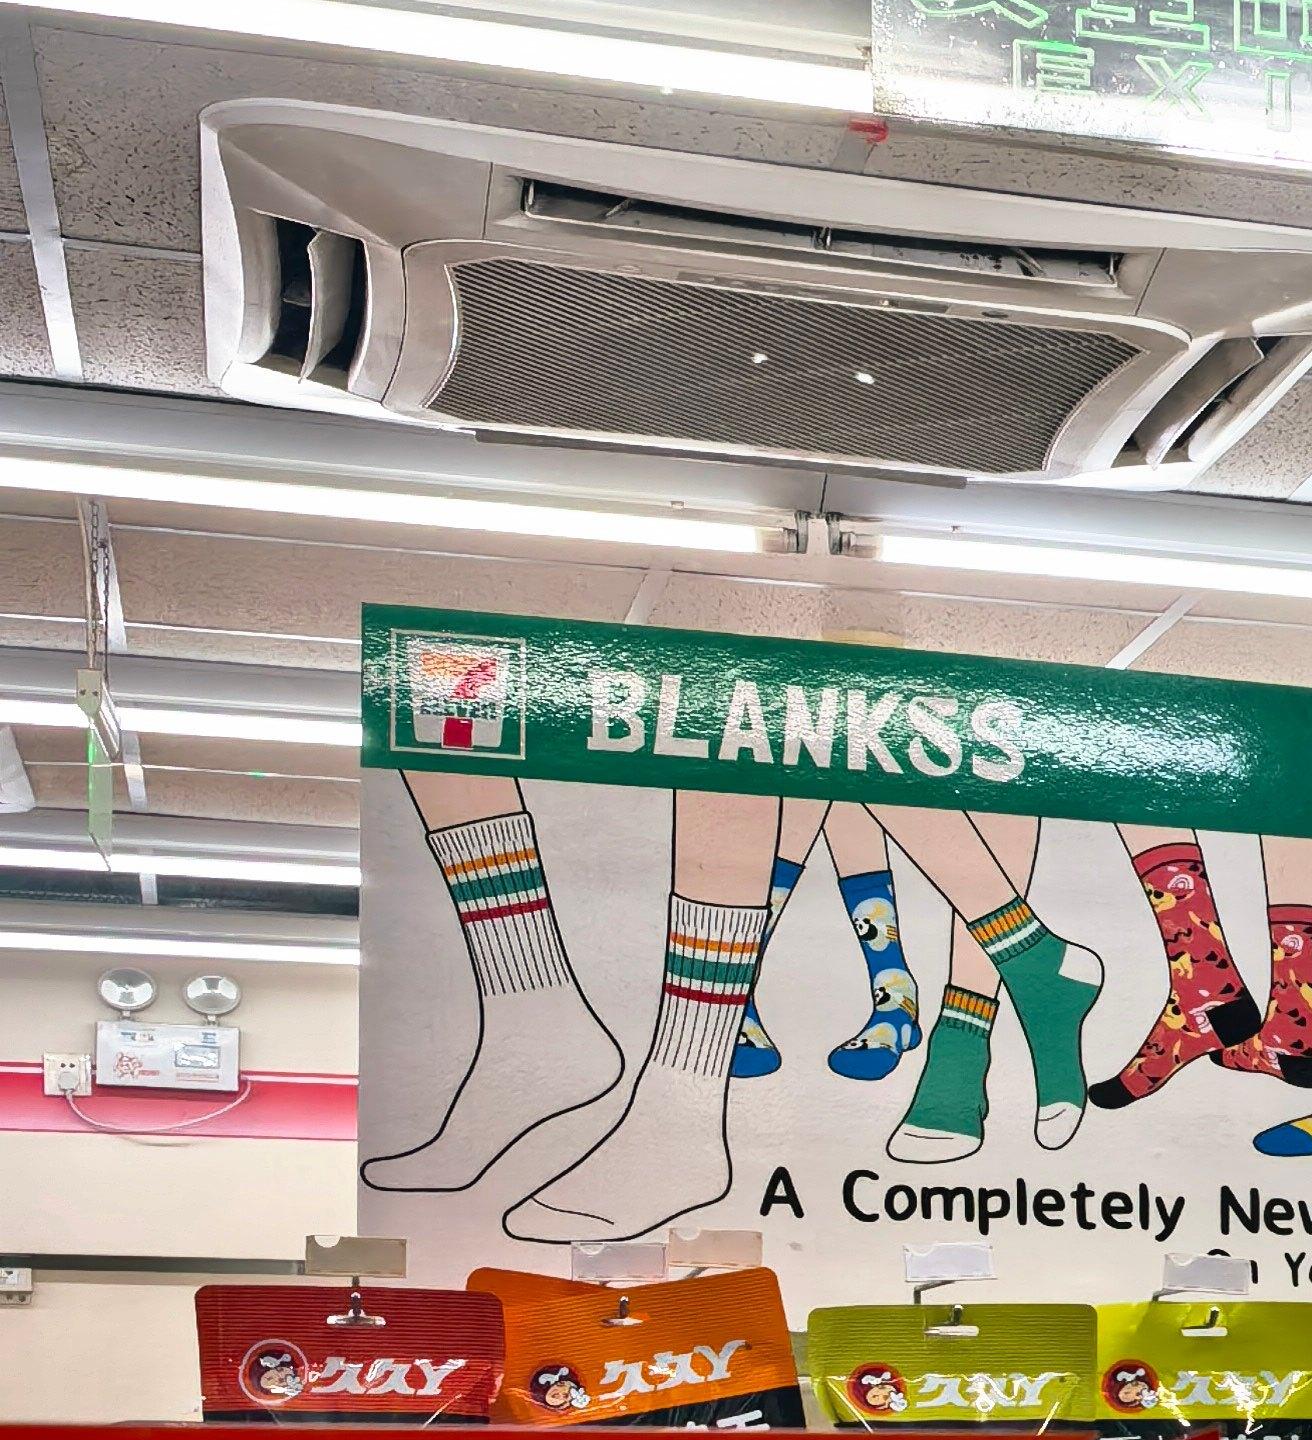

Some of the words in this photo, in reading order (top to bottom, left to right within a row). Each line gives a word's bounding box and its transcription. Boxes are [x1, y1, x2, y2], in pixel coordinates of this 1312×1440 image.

[587, 672, 1025, 782] BLANKSS
[759, 1167, 804, 1219] A
[842, 1168, 1187, 1241] Completely
